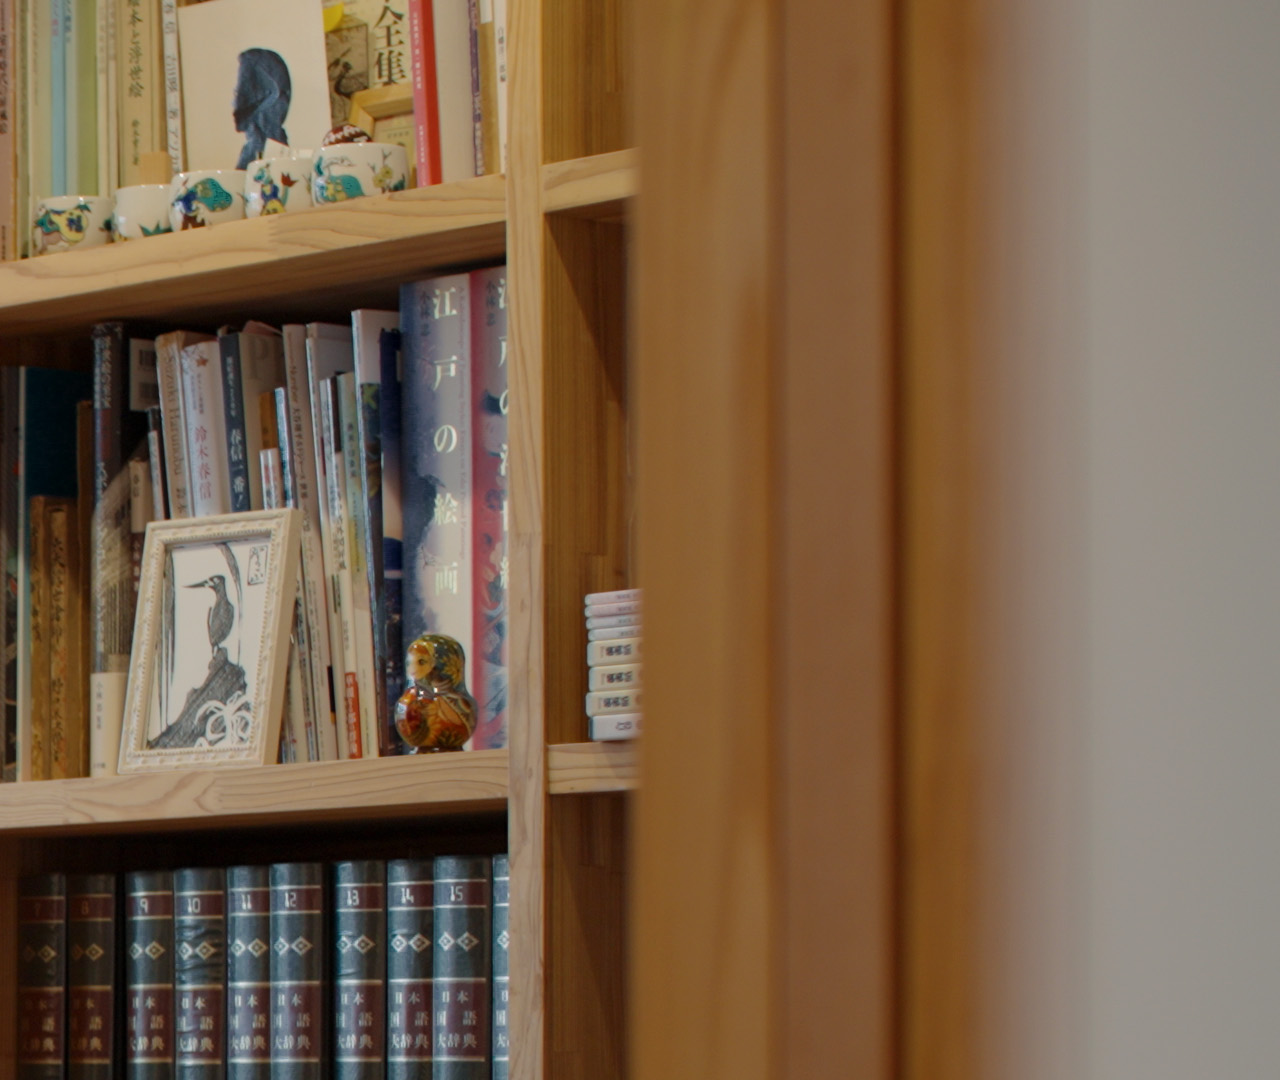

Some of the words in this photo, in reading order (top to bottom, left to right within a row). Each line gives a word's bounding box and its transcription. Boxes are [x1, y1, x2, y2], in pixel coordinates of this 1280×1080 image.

[432, 286, 458, 597] 江戸の絵画
[284, 891, 297, 908] 12
[346, 889, 360, 906] 13
[400, 887, 415, 904] 14
[450, 885, 464, 901] 15
[139, 898, 149, 914] 9
[187, 897, 201, 914] 10
[241, 894, 252, 911] 11
